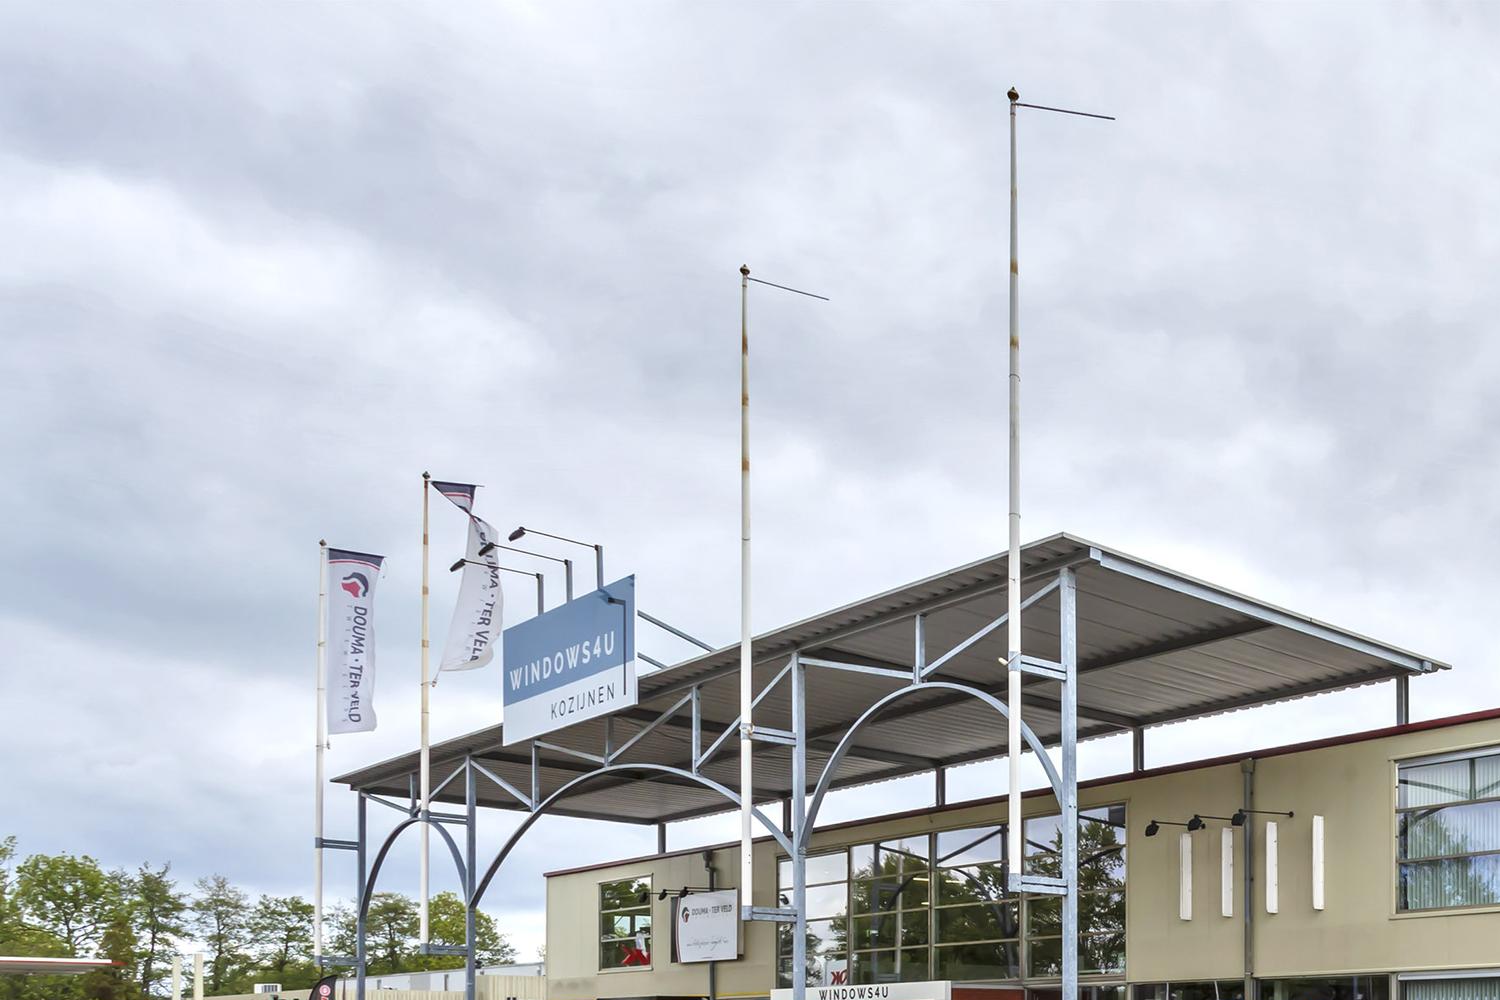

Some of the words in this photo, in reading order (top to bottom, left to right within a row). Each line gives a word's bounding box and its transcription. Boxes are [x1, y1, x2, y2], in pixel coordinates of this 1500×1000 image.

[477, 601, 496, 627] TER
[350, 605, 368, 655] DOUMA
[509, 631, 615, 691] WINDOWS4U
[349, 664, 363, 689] TER
[348, 690, 362, 723] VELD
[550, 682, 615, 720] KOZIJNEN
[691, 907, 709, 916] DOUMA
[711, 905, 720, 914] TER
[721, 904, 733, 913] VELD
[819, 986, 889, 1000] WINDOWS4U
